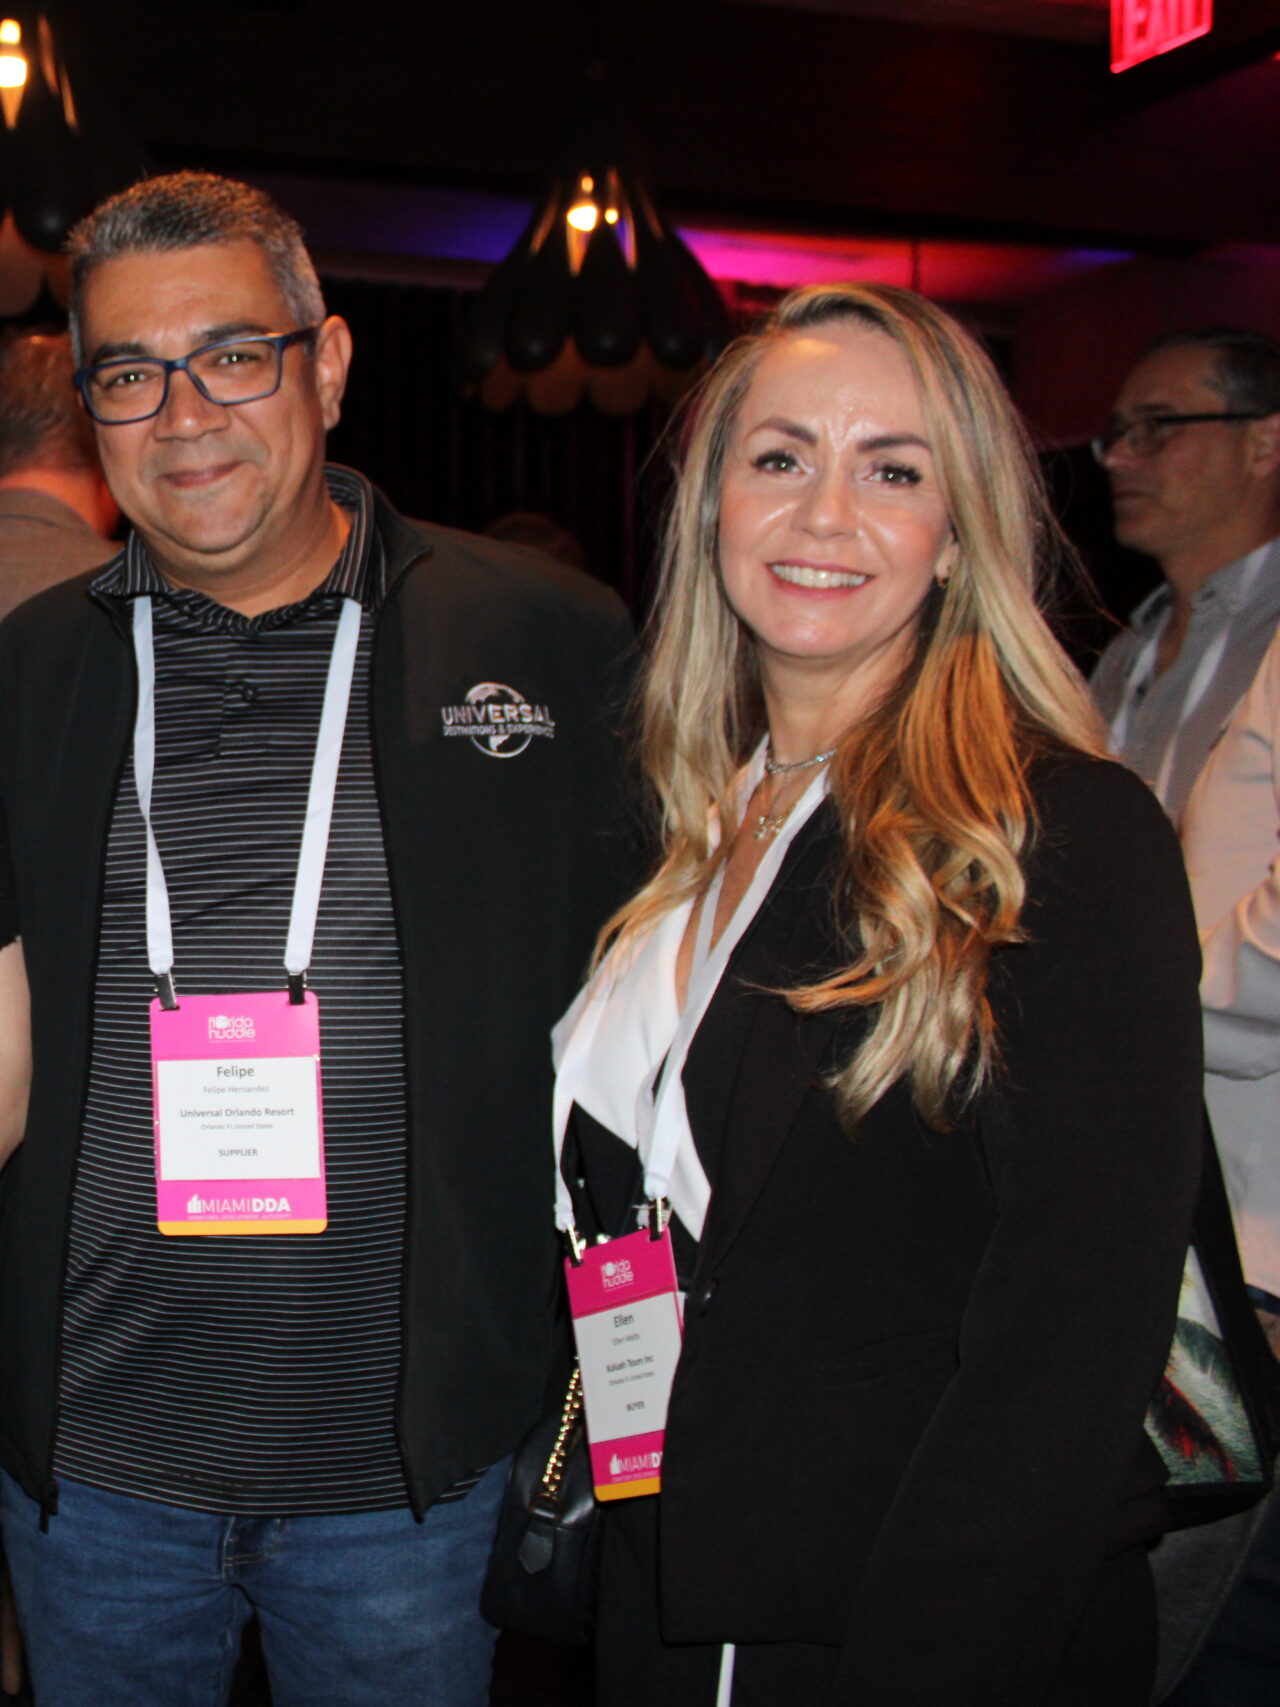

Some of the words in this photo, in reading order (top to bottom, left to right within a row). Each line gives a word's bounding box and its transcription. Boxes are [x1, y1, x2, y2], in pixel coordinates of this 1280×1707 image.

[441, 703, 556, 727] UNIVERSAL
[207, 1015, 254, 1029] florida
[208, 1027, 257, 1040] huddle
[216, 1066, 255, 1079] Felipe
[203, 1085, 226, 1095] Felipe
[180, 1108, 223, 1118] Universal
[224, 1107, 263, 1117] Orlando
[264, 1107, 295, 1117] Resort
[218, 1147, 259, 1158] SUPPLIER
[202, 1197, 292, 1214] MIAMIDDA
[613, 1314, 634, 1328] Ellen
[620, 1450, 664, 1473] MIAMID
